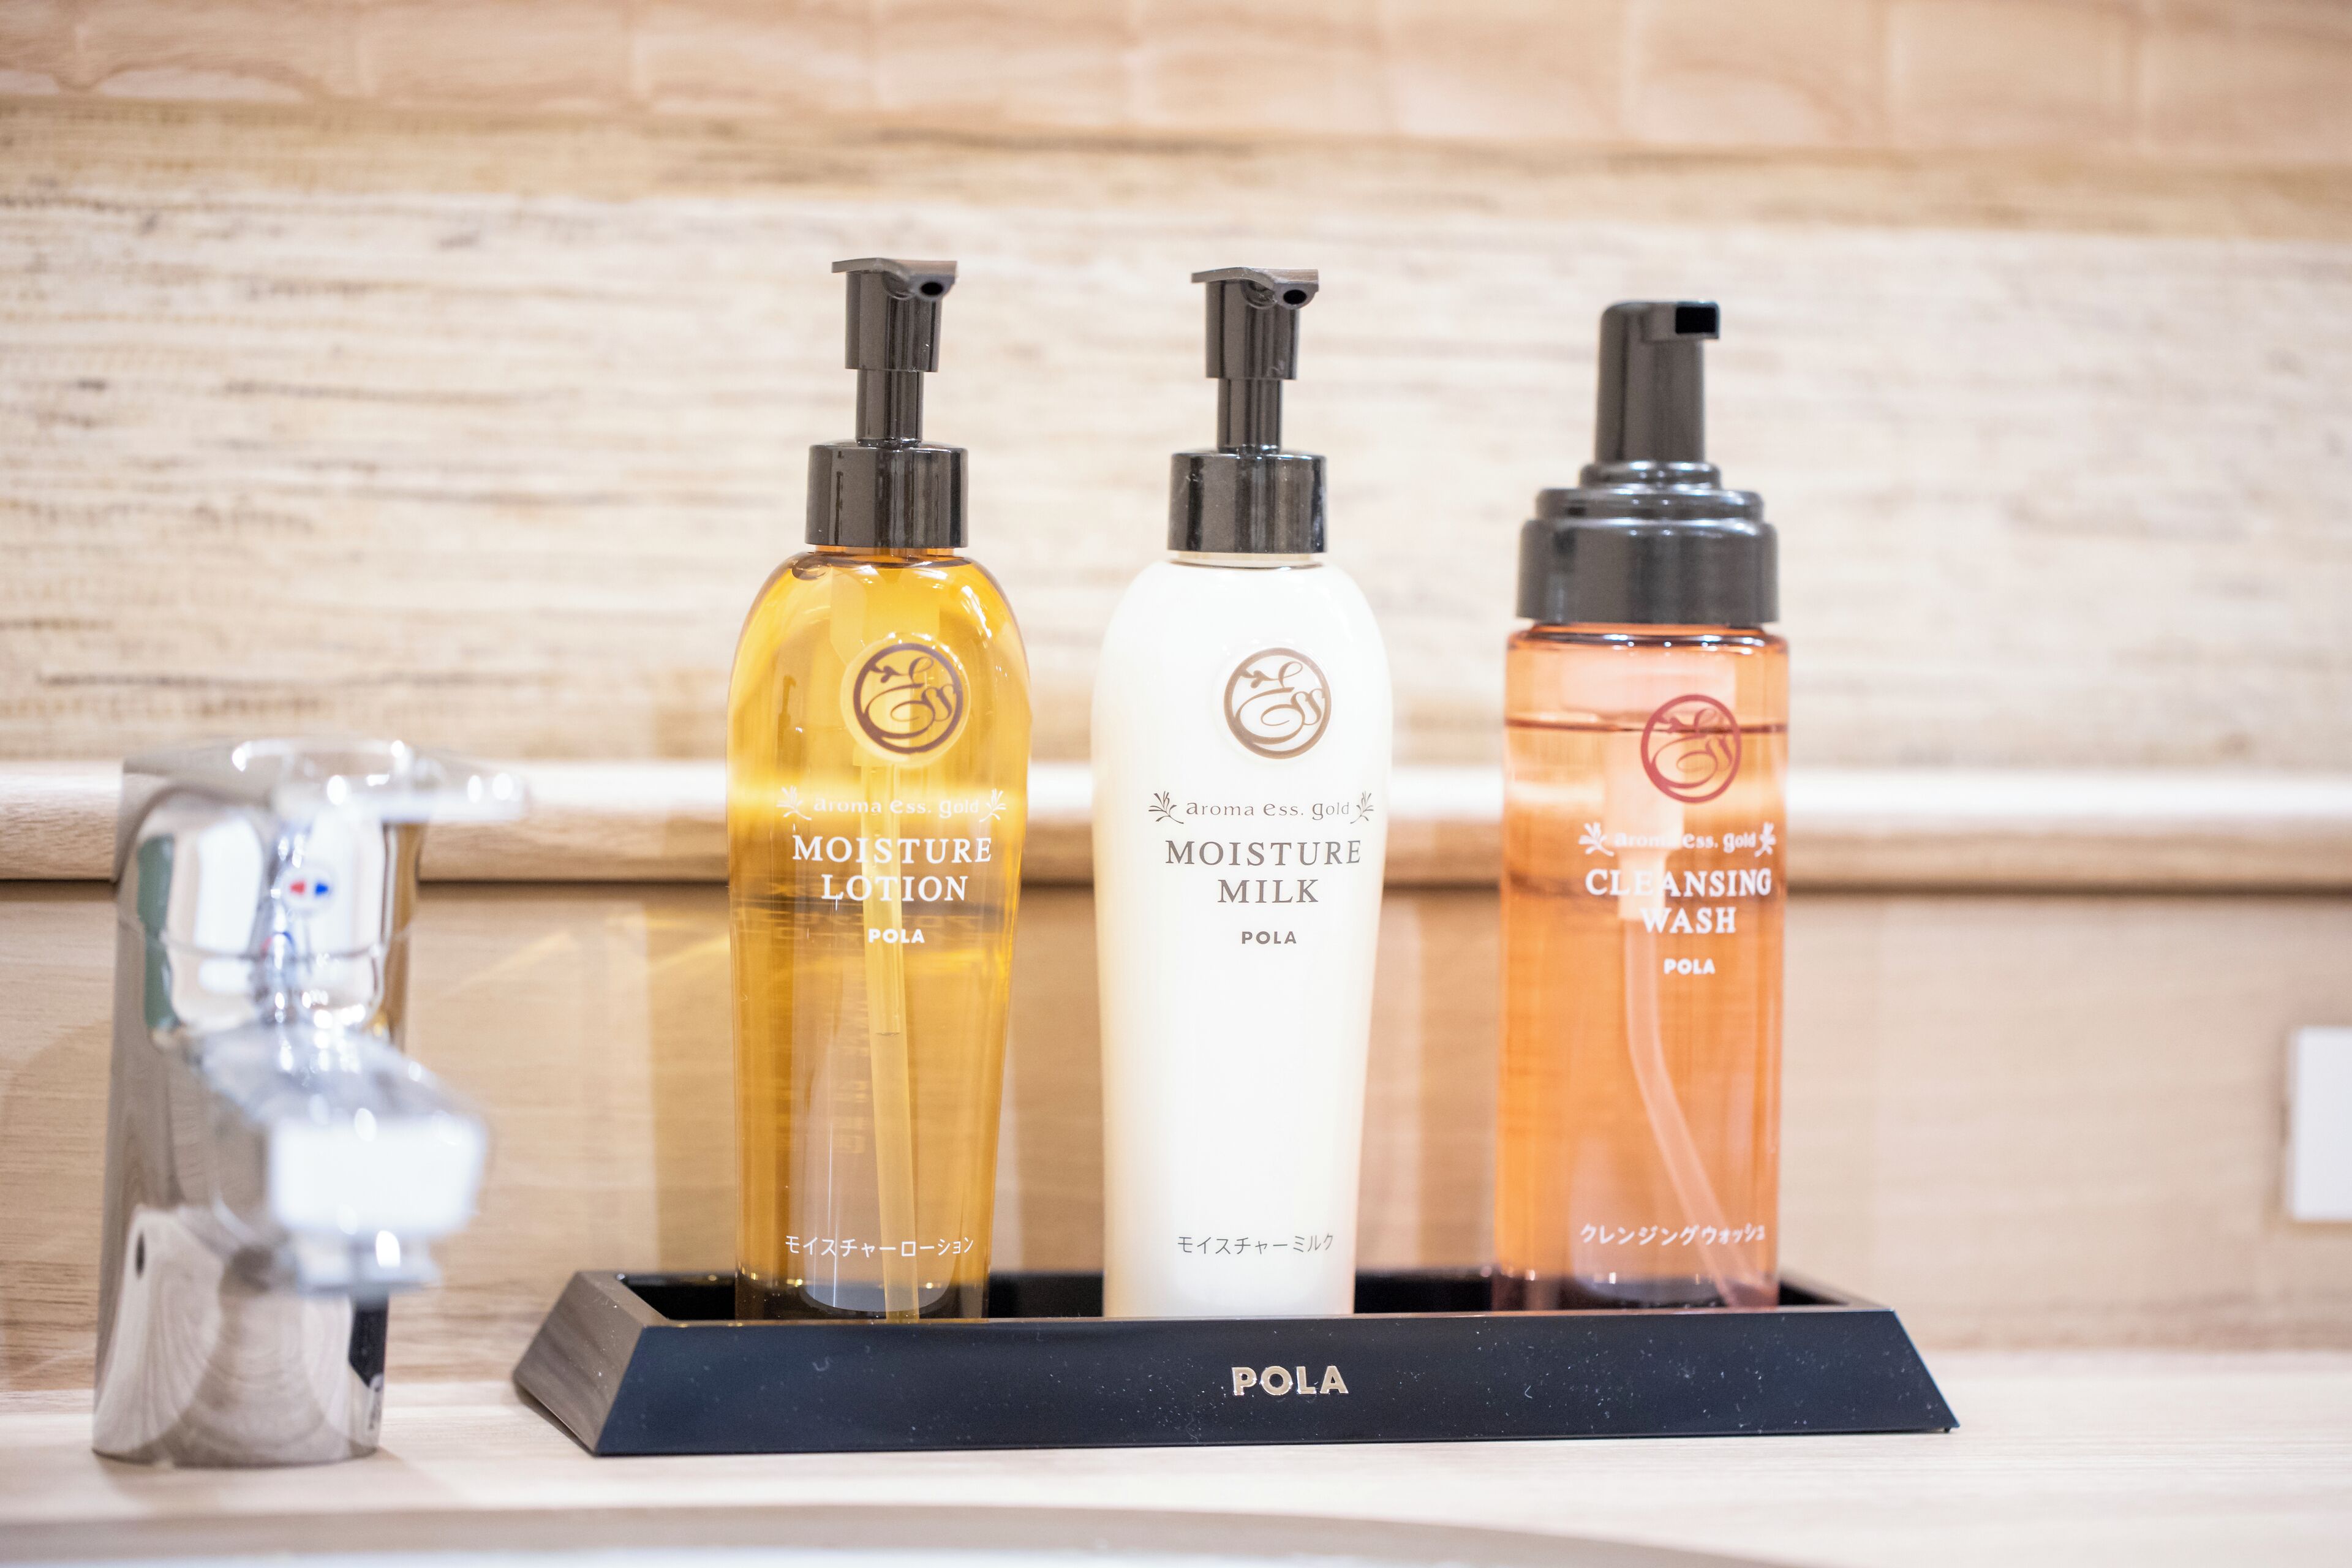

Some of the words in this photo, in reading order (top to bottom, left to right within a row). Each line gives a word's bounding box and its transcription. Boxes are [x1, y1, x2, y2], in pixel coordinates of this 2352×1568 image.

[813, 797, 882, 813] aroma
[890, 799, 932, 814] ess.
[940, 798, 979, 819] gold
[1186, 802, 1255, 816] aroma
[1262, 802, 1304, 816] ess.
[1311, 801, 1350, 821] gold
[792, 835, 992, 864] MOISTURE
[1164, 839, 1362, 867] MOISTURE
[1682, 832, 1718, 850] ess.
[1722, 832, 1756, 853] gold
[821, 873, 968, 902] LOTION
[1217, 878, 1319, 903] MILK
[1585, 867, 1773, 898] CLEANSING
[1640, 906, 1737, 935] WASH
[868, 928, 925, 944] POLA
[1241, 930, 1297, 945] POLA
[1663, 958, 1716, 976] POLA
[1177, 1232, 1333, 1255] モイスチャーミルク
[1580, 1222, 1765, 1246] クレンジングウォッシュ
[785, 1235, 974, 1258] モイスチャーローション
[1231, 1365, 1349, 1396] POLA
